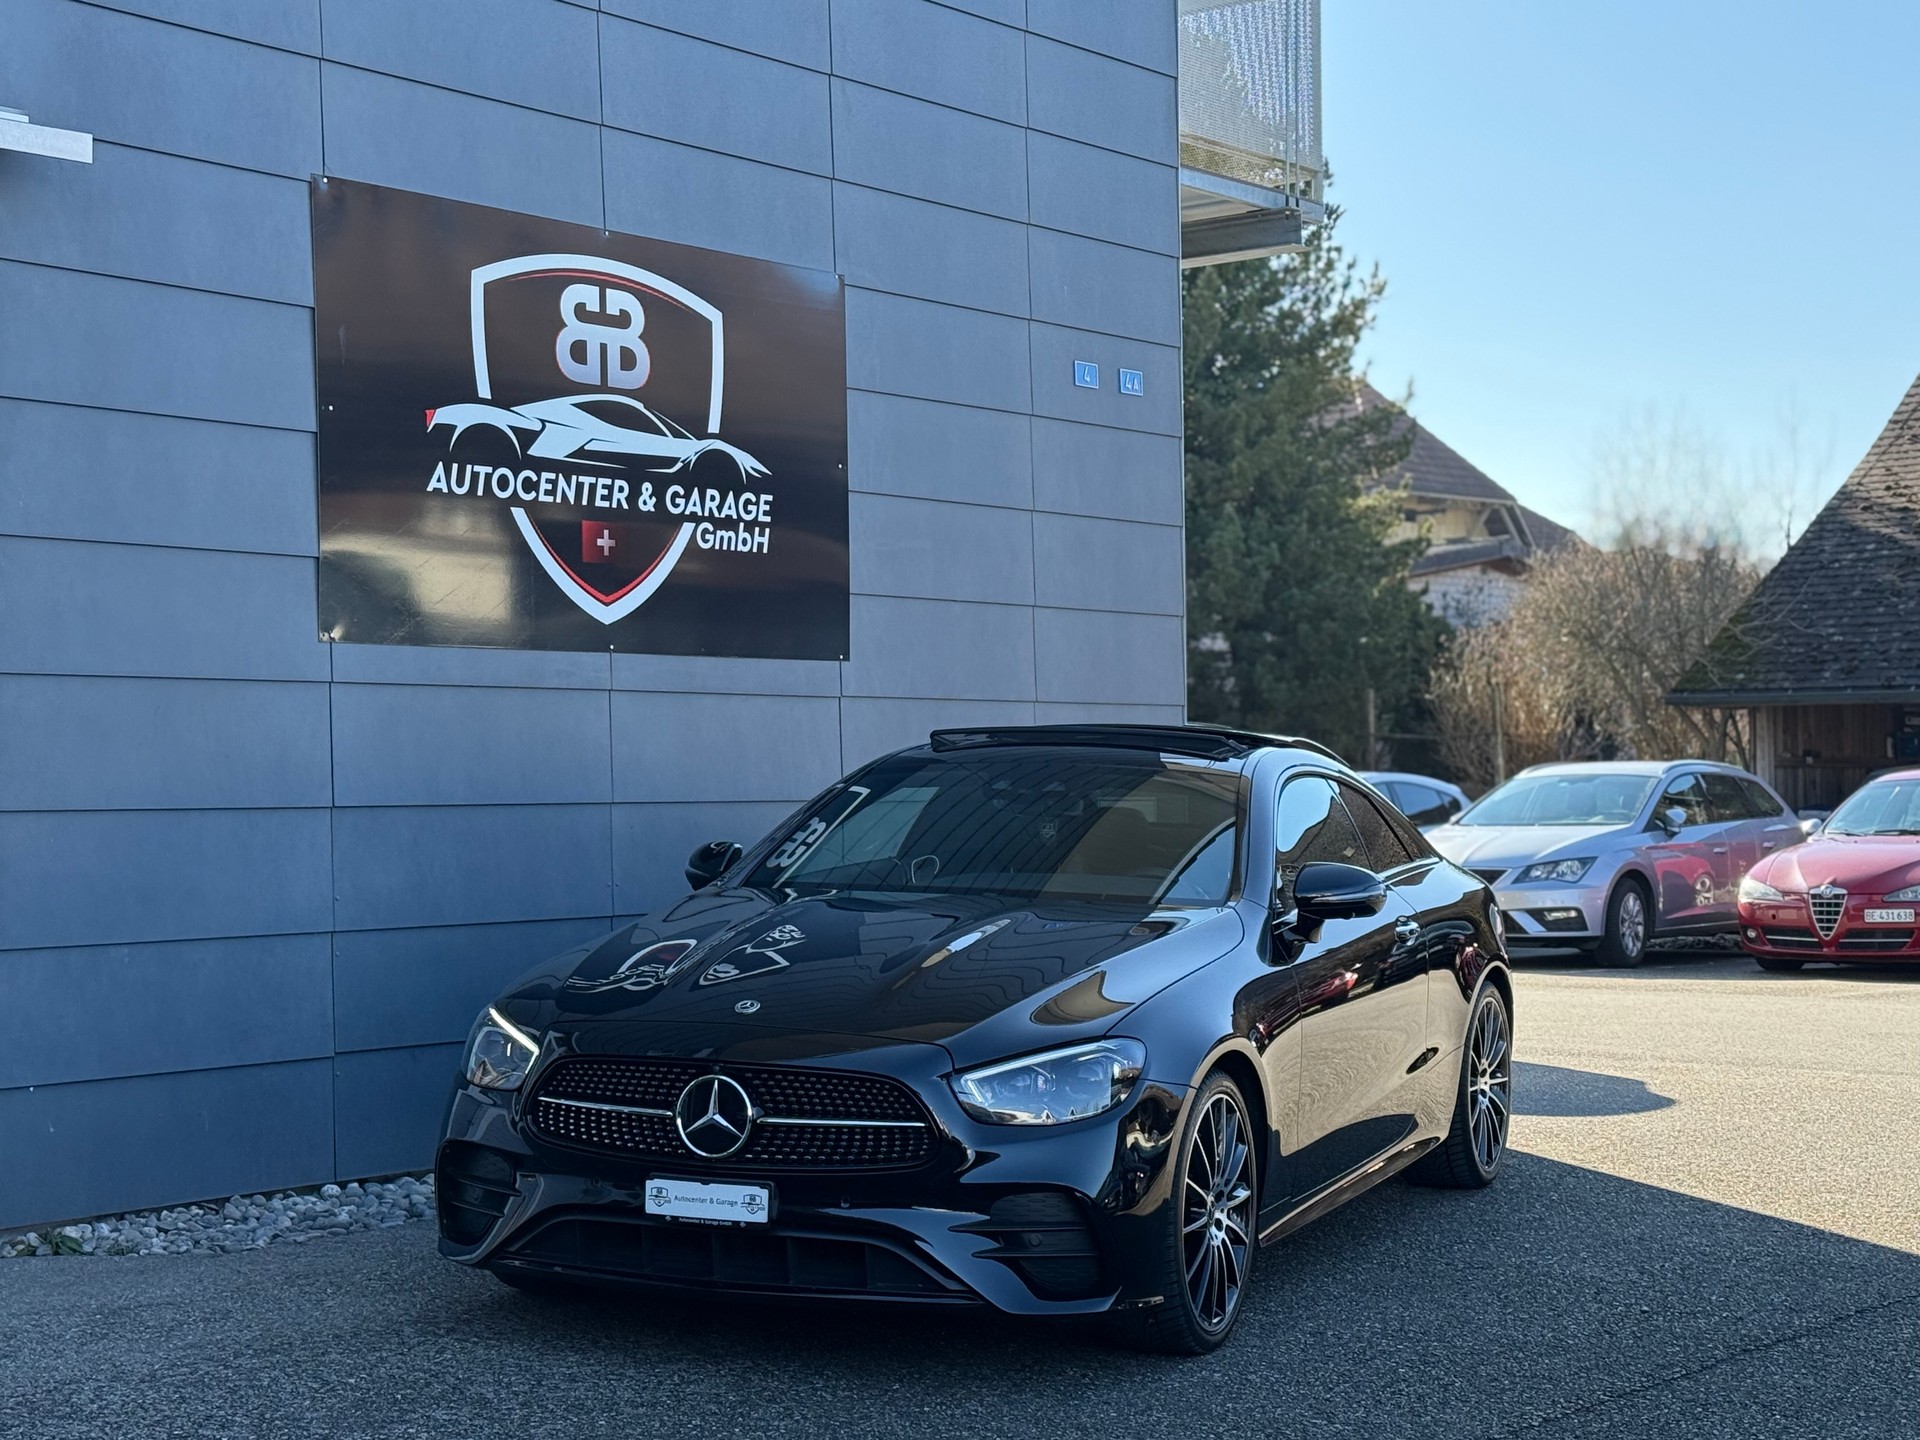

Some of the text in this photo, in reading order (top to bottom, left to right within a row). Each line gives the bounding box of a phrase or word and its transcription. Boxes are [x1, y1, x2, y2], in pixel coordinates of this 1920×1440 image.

[1084, 366, 1090, 383] 4
[1125, 373, 1139, 391] 4A
[426, 460, 774, 523] AUTOCENTER & GARAGE
[695, 521, 770, 554] GmbH
[673, 1194, 708, 1204] Autocenter
[709, 1197, 714, 1205] &
[715, 1198, 738, 1208] Garage
